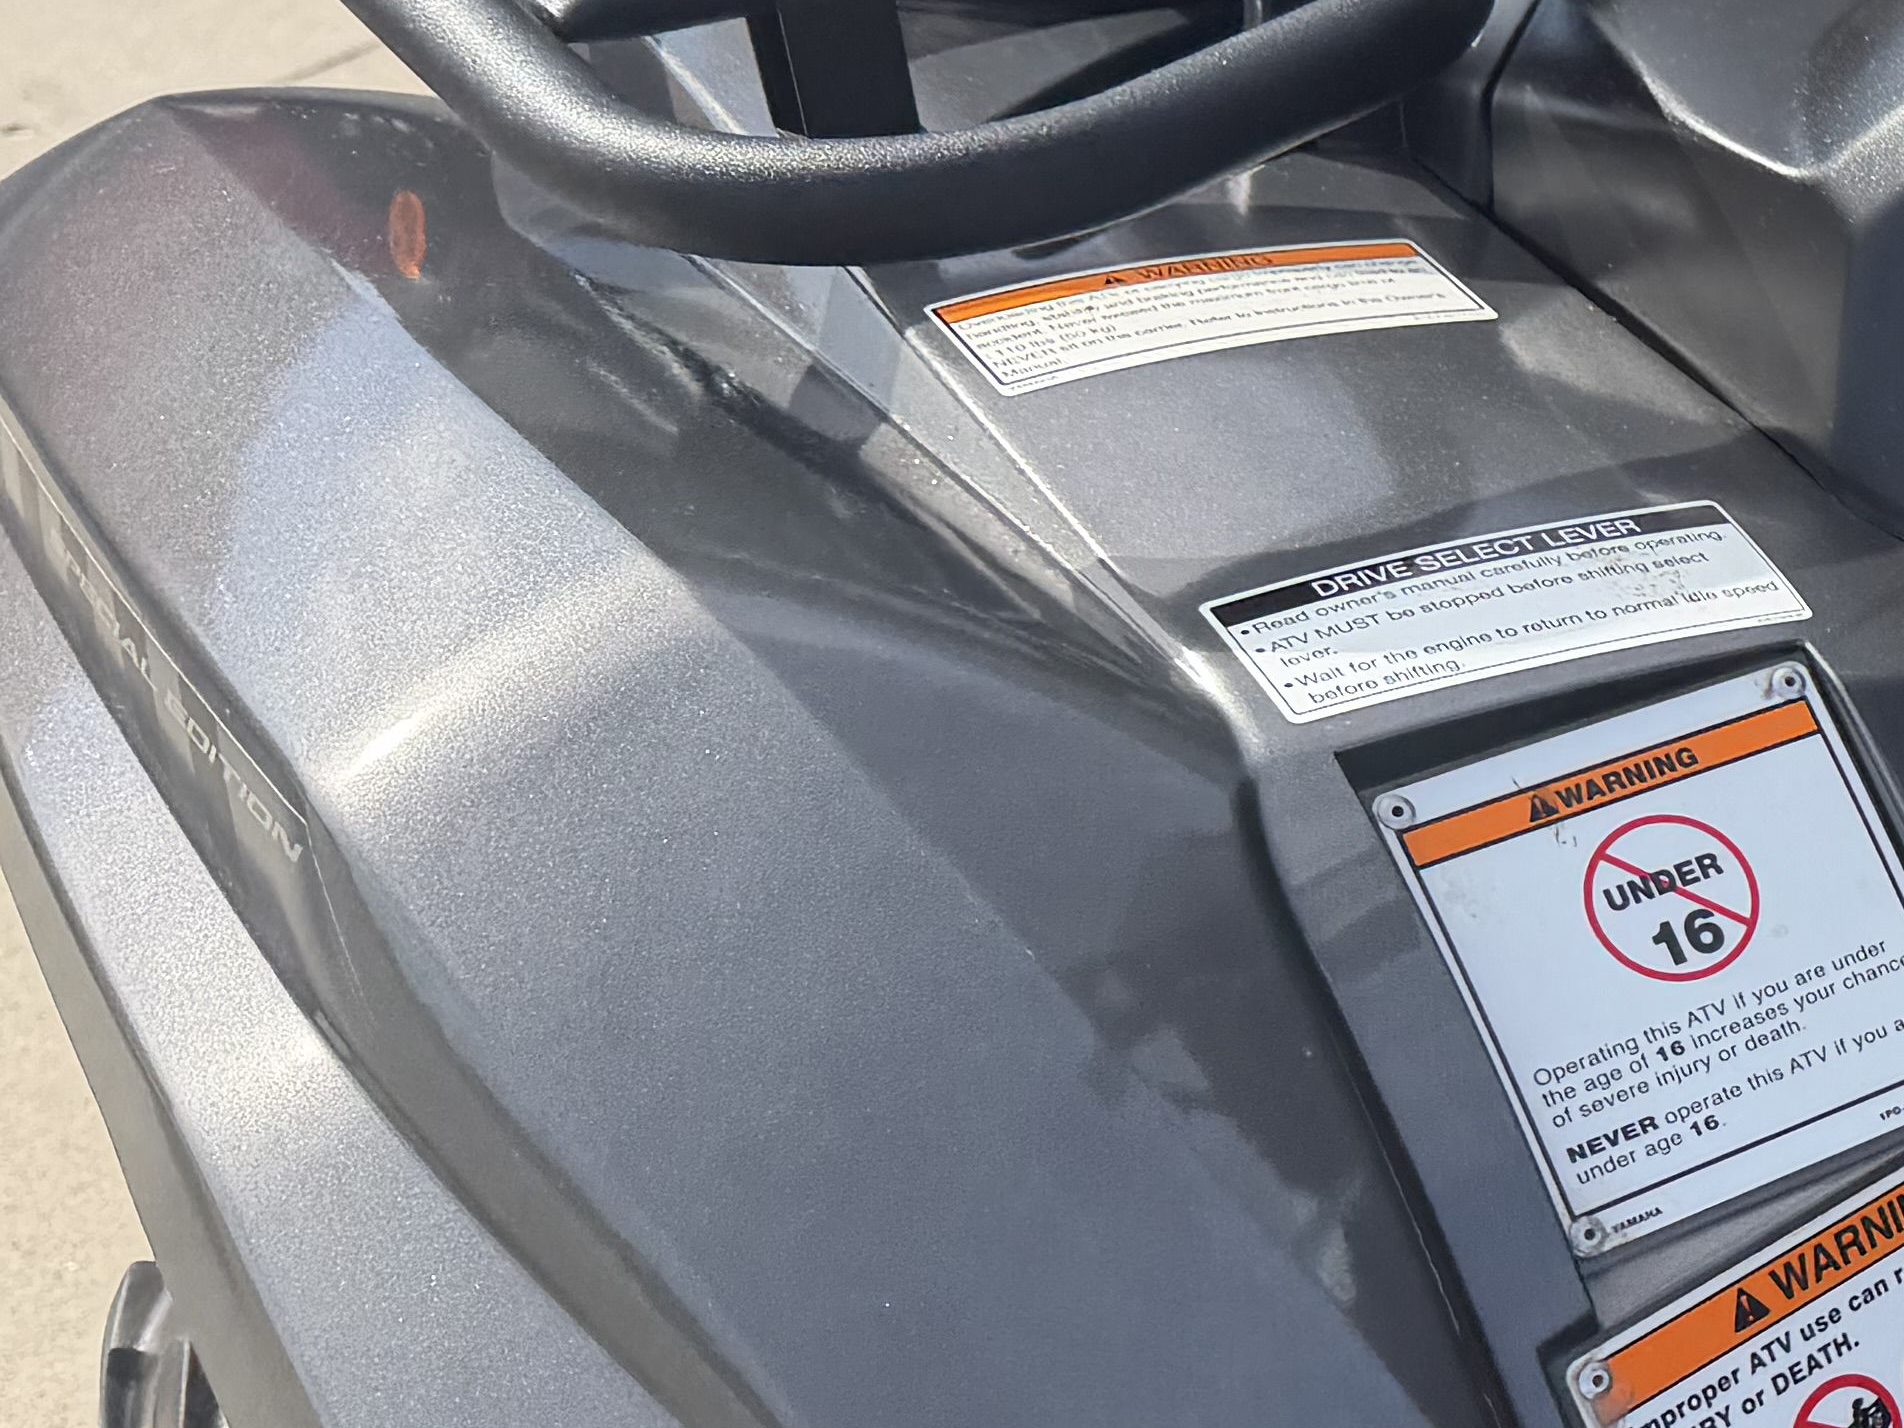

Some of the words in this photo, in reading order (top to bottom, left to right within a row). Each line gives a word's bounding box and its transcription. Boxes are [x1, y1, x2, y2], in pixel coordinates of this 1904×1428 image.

[1136, 255, 1272, 281] WARNING
[1252, 611, 1310, 634] Read
[1315, 592, 1397, 616] owner's
[1400, 574, 1476, 595] manual
[1480, 555, 1561, 578] carefully
[1565, 545, 1630, 561] before
[1312, 562, 1411, 597] DRIVE
[1420, 534, 1534, 573] SELECT
[1541, 519, 1641, 548] LEVER
[1271, 632, 1308, 652] ATV
[1314, 613, 1379, 639] MUST
[1385, 609, 1415, 621] be
[1419, 587, 1505, 613] stopped
[1507, 576, 1573, 594] before
[1578, 563, 1649, 581] shifting
[1652, 552, 1709, 568] select
[1294, 667, 1344, 686] Wait
[1349, 659, 1377, 673] for
[1383, 650, 1418, 664] the
[1423, 633, 1492, 653] engine
[1495, 628, 1518, 638] to
[1522, 615, 1583, 633] return
[1585, 610, 1607, 621] to
[1611, 595, 1679, 616] normal
[1680, 591, 1717, 603] idle
[1722, 581, 1779, 598] speed
[1280, 647, 1339, 667] lever.
[1308, 680, 1378, 704] before
[1554, 747, 1699, 808] WARNING
[1602, 853, 1724, 911] UNDER
[1652, 909, 1725, 966] 16
[1533, 1038, 1639, 1086] Operating
[1643, 1022, 1681, 1044] this
[1688, 998, 1724, 1028] ATV
[1733, 992, 1746, 1009] if
[1752, 980, 1789, 1006] you
[1794, 966, 1826, 986] are
[1831, 941, 1885, 971] under
[1542, 1086, 1576, 1107] the
[1584, 1068, 1623, 1092] age
[1629, 1053, 1649, 1074] of
[1656, 1040, 1685, 1062] 16
[1690, 1003, 1789, 1049] increases
[1793, 983, 1835, 1013] your
[1553, 1106, 1572, 1128] of
[1579, 1081, 1649, 1117] severe
[1655, 1055, 1710, 1086] injury
[1718, 1045, 1737, 1061] or
[1745, 1021, 1806, 1051] death.
[1566, 1116, 1659, 1163] NEVER
[1665, 1086, 1742, 1124] operate
[1747, 1068, 1784, 1091] this
[1791, 1045, 1826, 1074] ATV
[1834, 1038, 1847, 1055] if
[1852, 1026, 1887, 1052] you
[1576, 1150, 1636, 1184] under
[1645, 1133, 1683, 1156] age
[1750, 1331, 1791, 1375] ATV
[1800, 1308, 1842, 1341] use
[1848, 1279, 1889, 1312] can
[1742, 1389, 1764, 1414] or
[1771, 1333, 1860, 1396] DEATH.
